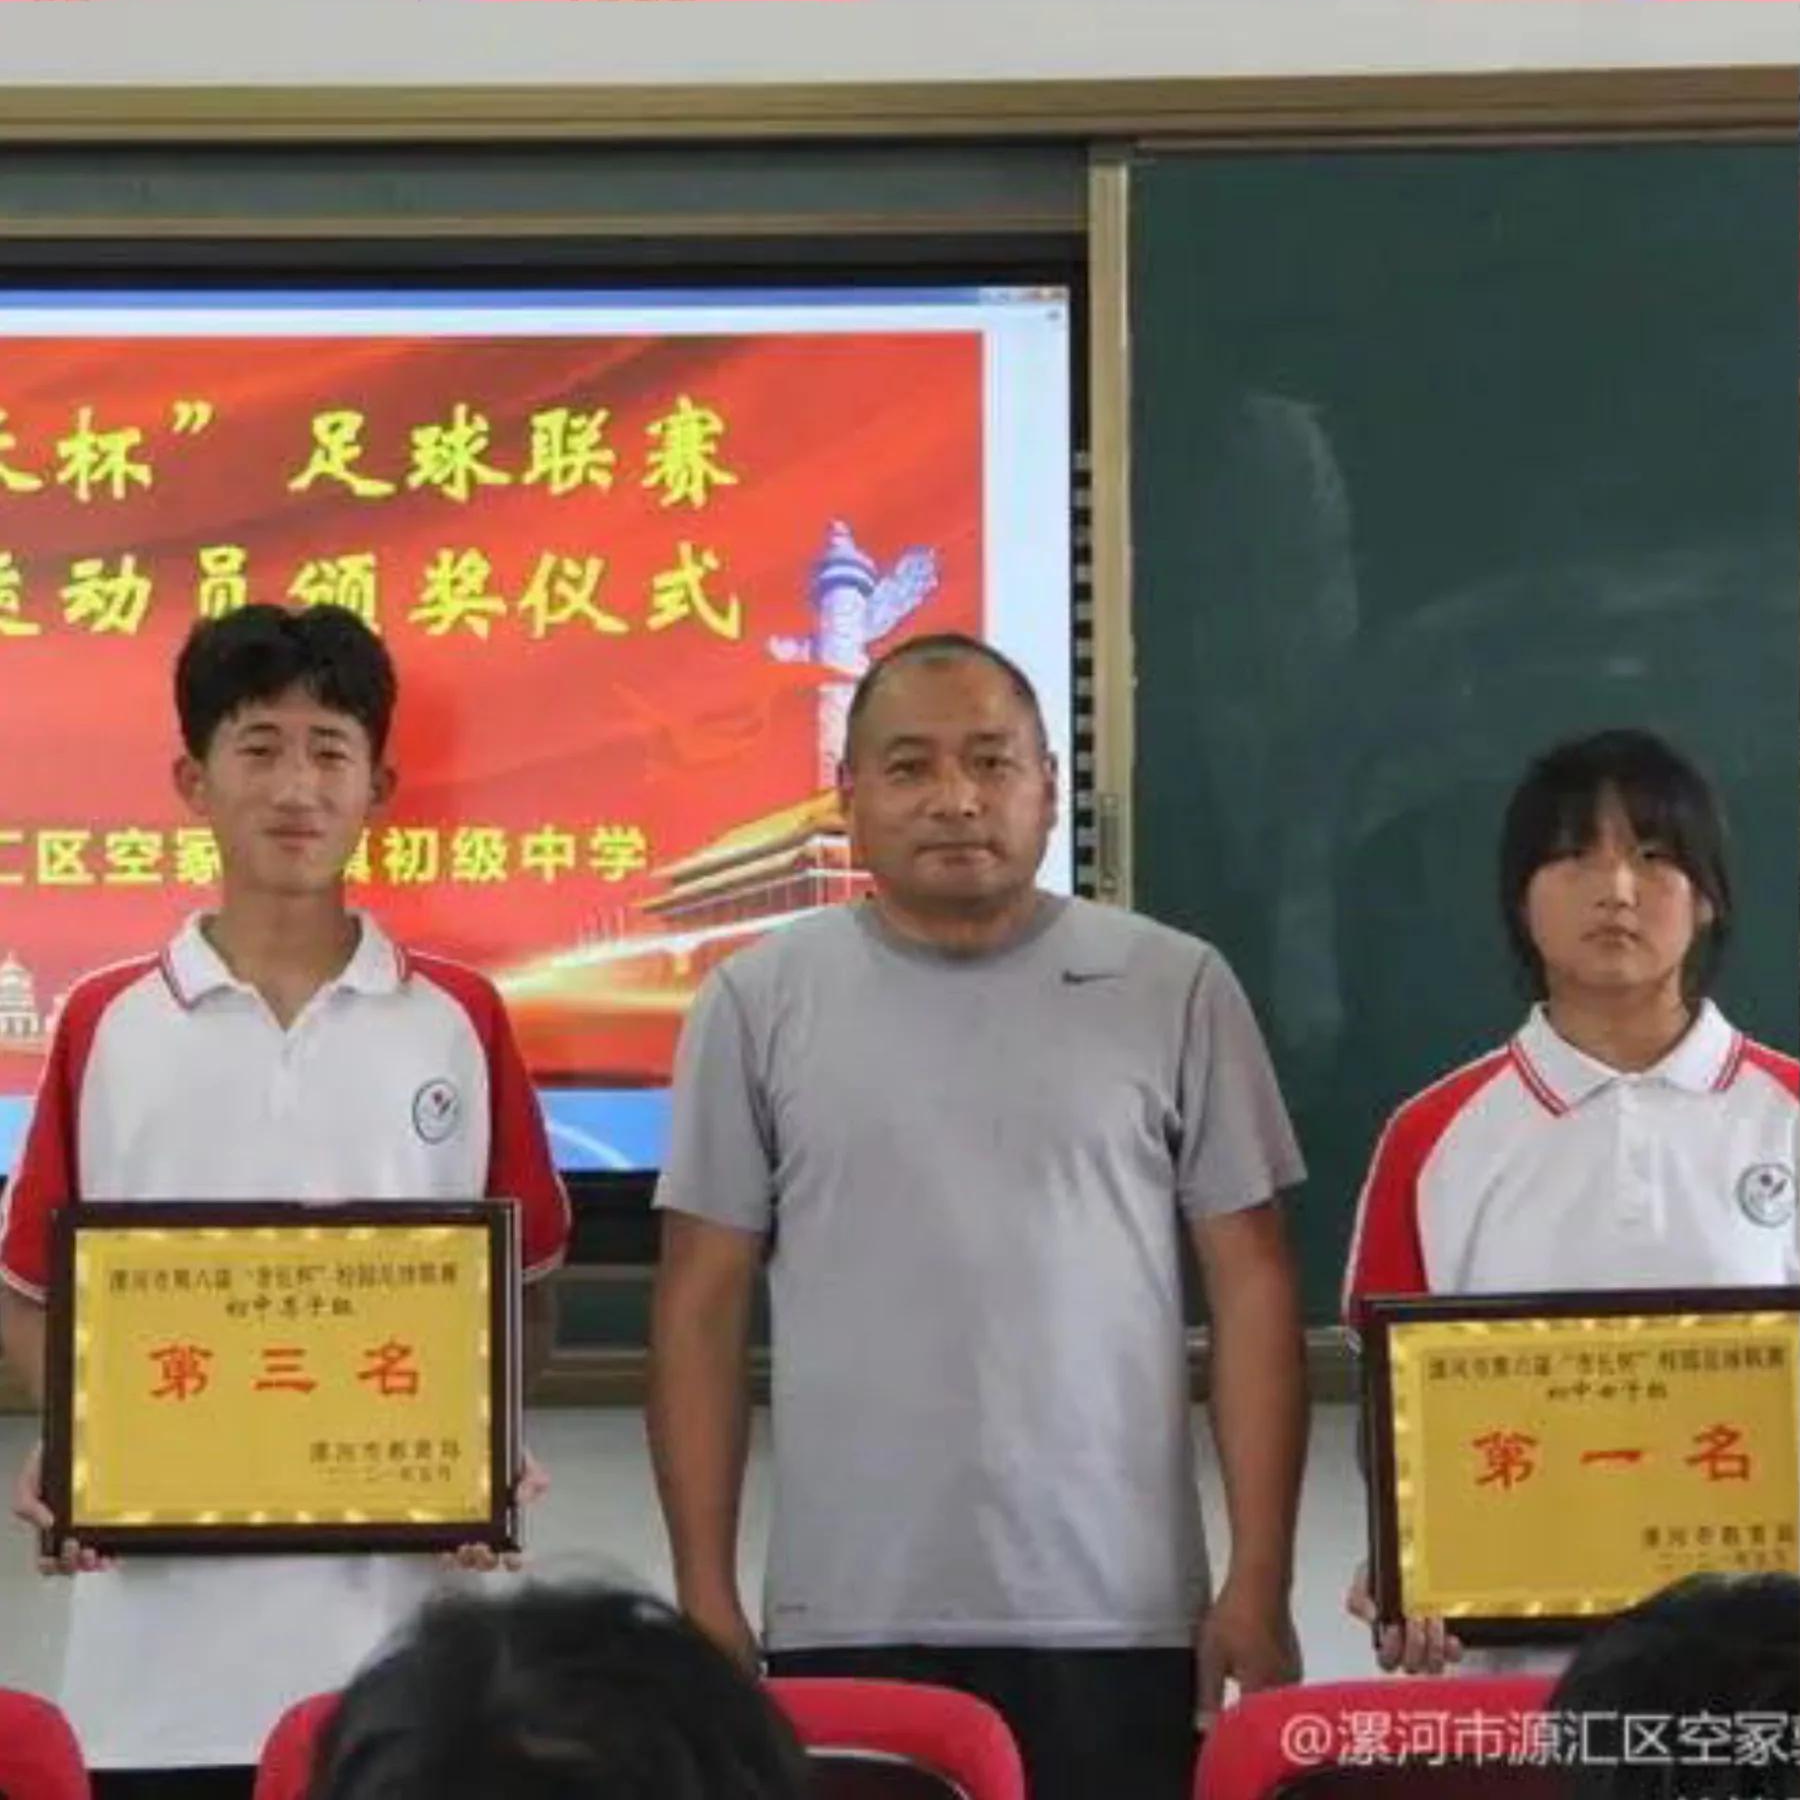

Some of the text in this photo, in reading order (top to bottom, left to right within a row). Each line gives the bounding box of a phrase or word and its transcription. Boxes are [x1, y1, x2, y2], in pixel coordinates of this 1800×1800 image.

[146, 1336, 420, 1402] 第三名
[1471, 1424, 1751, 1490] 第一名
